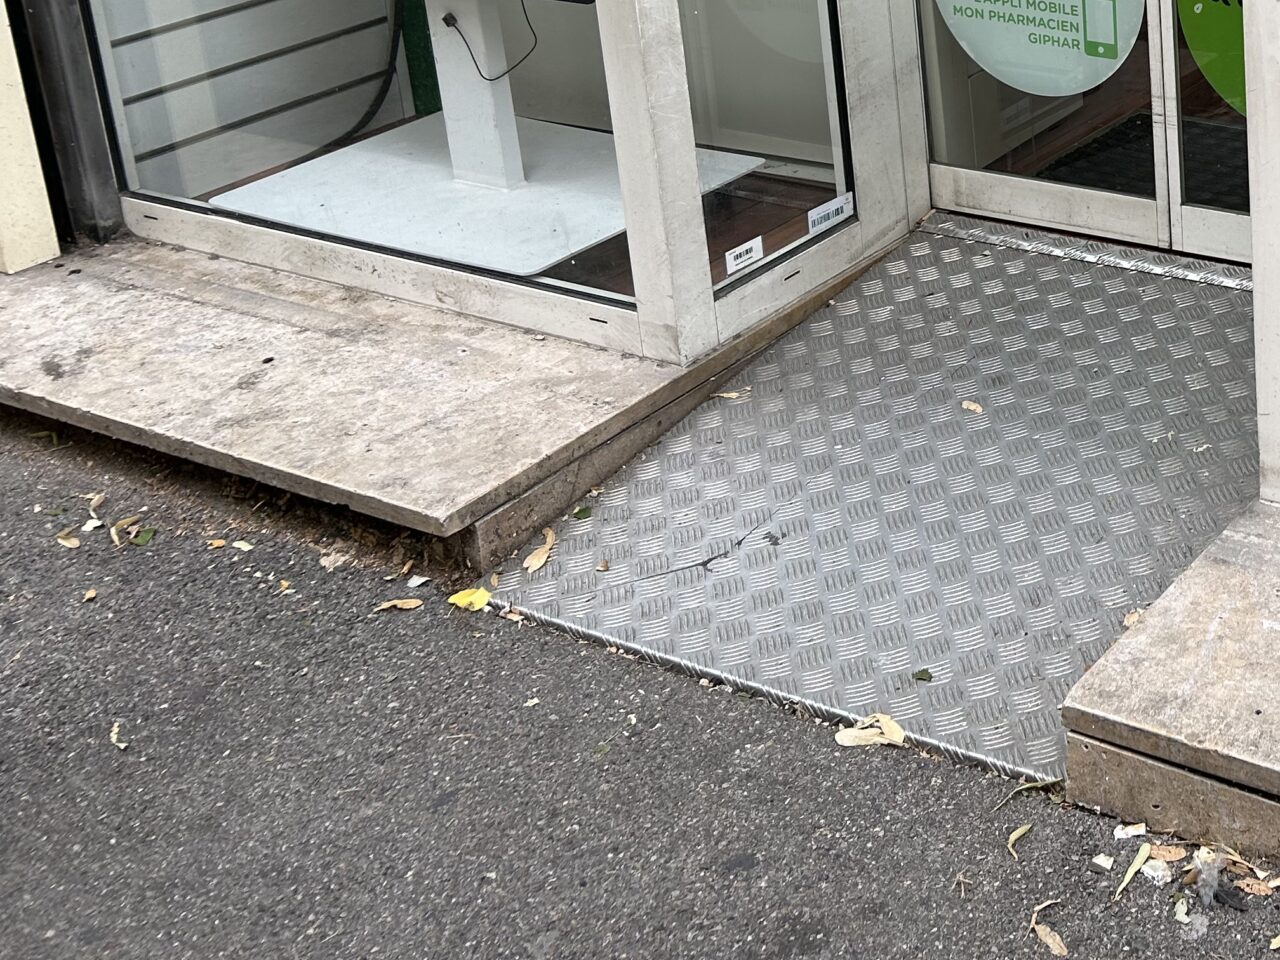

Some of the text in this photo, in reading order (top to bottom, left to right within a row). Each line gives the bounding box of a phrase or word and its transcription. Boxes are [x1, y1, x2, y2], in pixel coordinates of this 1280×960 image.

[1026, 0, 1079, 16] MOBILE
[953, 5, 1079, 33] MON PHARMACIEN
[1028, 33, 1080, 50] GIPHAR
